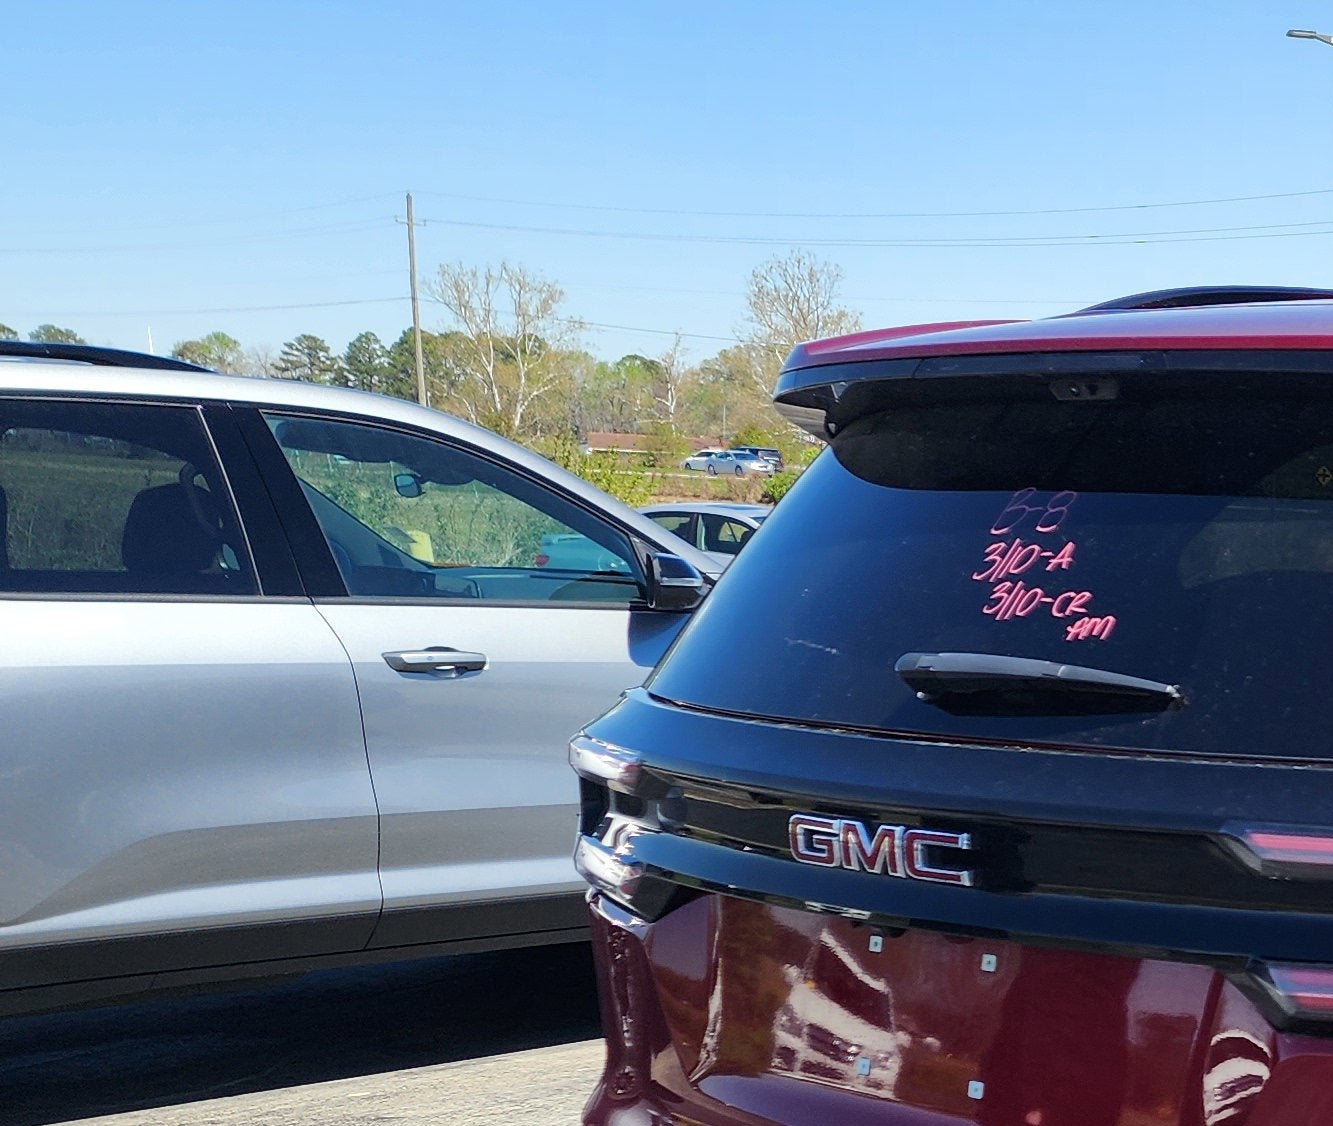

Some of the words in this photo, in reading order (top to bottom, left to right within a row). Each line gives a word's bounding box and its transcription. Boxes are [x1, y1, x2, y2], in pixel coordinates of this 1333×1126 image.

[971, 538, 1077, 583] 3/10-A
[981, 580, 1095, 621] 3/10-CR
[1064, 615, 1117, 642] AM
[788, 813, 974, 887] GMC
